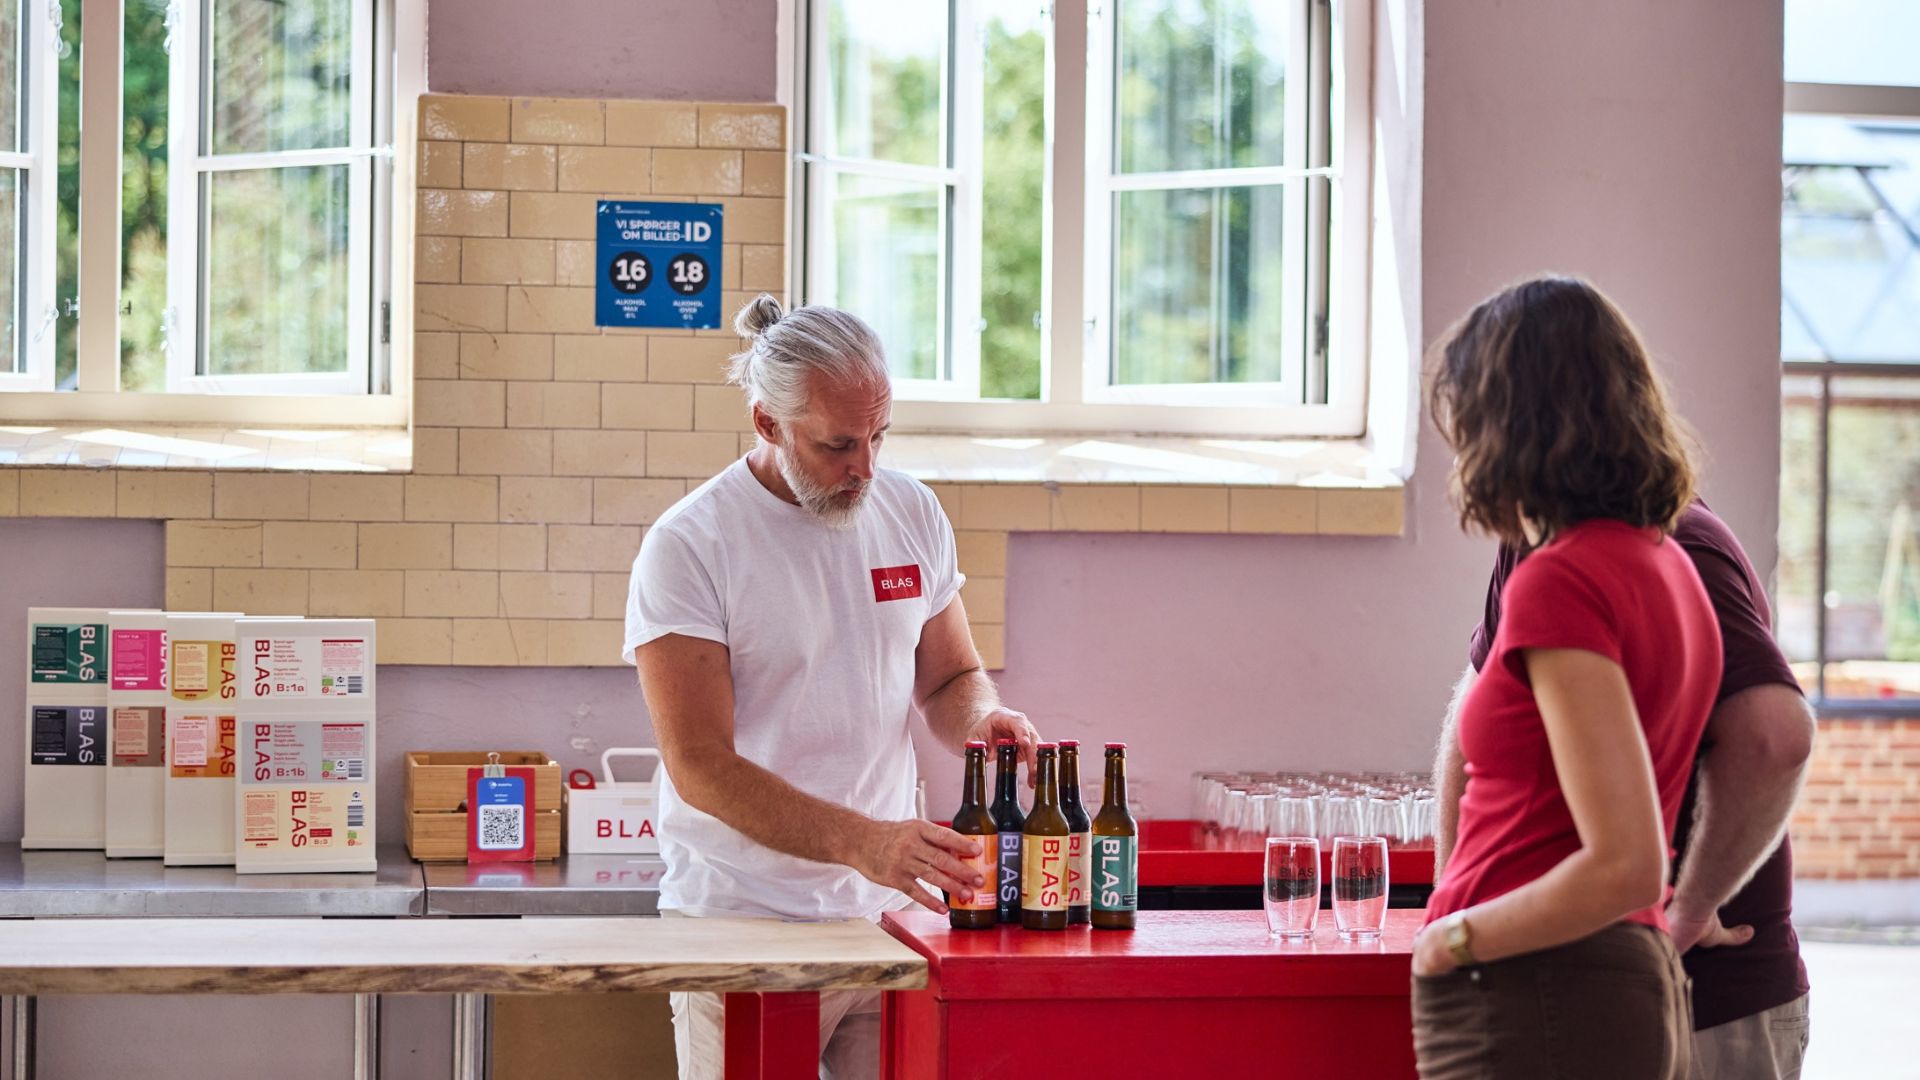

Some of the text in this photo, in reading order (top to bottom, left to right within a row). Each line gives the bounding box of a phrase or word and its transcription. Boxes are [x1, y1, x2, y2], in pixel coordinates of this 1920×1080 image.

[615, 220, 680, 230] VI SPØRGER
[622, 230, 640, 240] OM
[616, 258, 646, 282] 16
[673, 260, 704, 283] 18
[672, 300, 704, 308] ALKOHOL
[881, 577, 914, 589] BLAS
[80, 626, 96, 681] BLAS
[221, 644, 236, 699] BLAS
[255, 640, 270, 696] BLAS
[276, 684, 304, 692] B:1a
[79, 709, 94, 763] BLAS
[220, 720, 235, 774] BLAS
[255, 724, 270, 781] BLAS
[276, 768, 304, 776] B:1b
[292, 791, 307, 847] BLAS
[1001, 835, 1019, 902] BLAS
[1042, 840, 1060, 907] BLAS
[1102, 840, 1120, 907] BLAS
